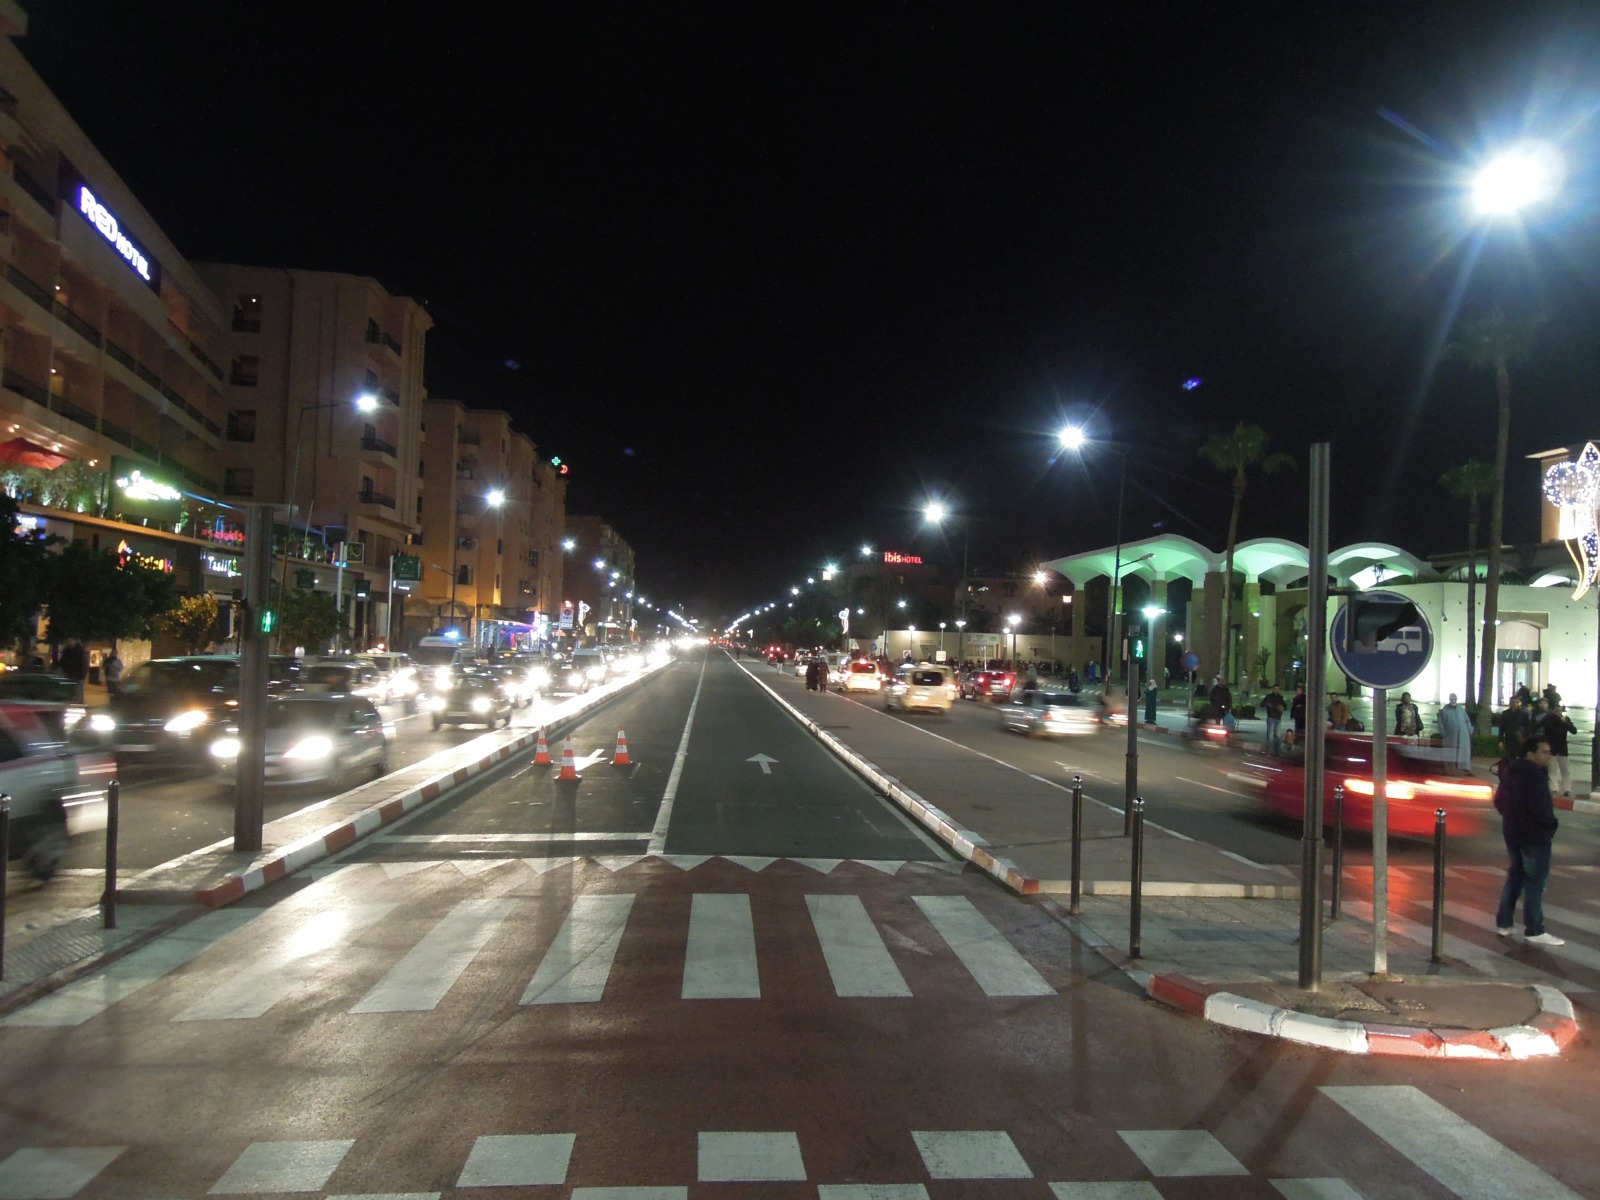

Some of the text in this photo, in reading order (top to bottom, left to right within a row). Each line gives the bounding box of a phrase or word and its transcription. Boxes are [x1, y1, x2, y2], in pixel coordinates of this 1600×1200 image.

[80, 186, 151, 281] RED HOTEL
[884, 551, 923, 564] ibis HOTEL
